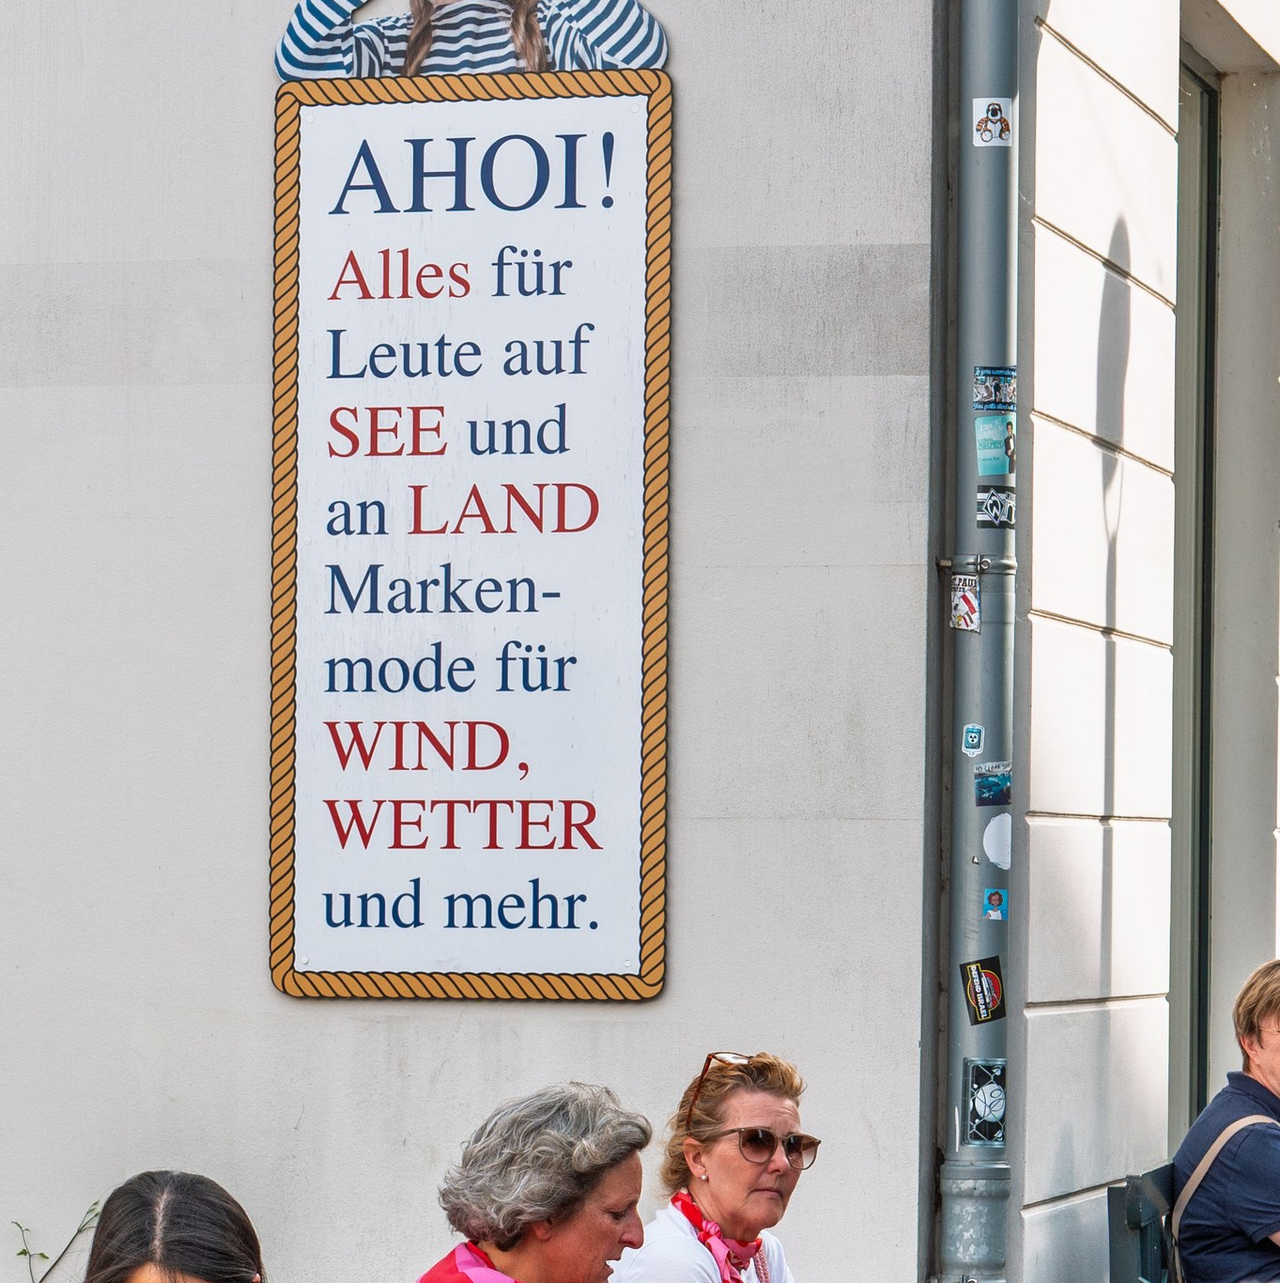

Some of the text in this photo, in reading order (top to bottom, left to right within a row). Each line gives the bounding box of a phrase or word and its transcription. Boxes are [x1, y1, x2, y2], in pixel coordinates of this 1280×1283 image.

[328, 131, 615, 215] AHOI!
[327, 245, 573, 301] Alles für
[326, 322, 596, 379] Leute auf
[327, 402, 569, 458] SEE und
[326, 482, 600, 536] an LAND
[324, 562, 561, 615] Marken-
[323, 640, 578, 694] mode für
[323, 720, 529, 781] WIND,
[322, 799, 603, 850] WETTER
[321, 877, 599, 930] und mehr.
[970, 965, 981, 993] DEFEND
